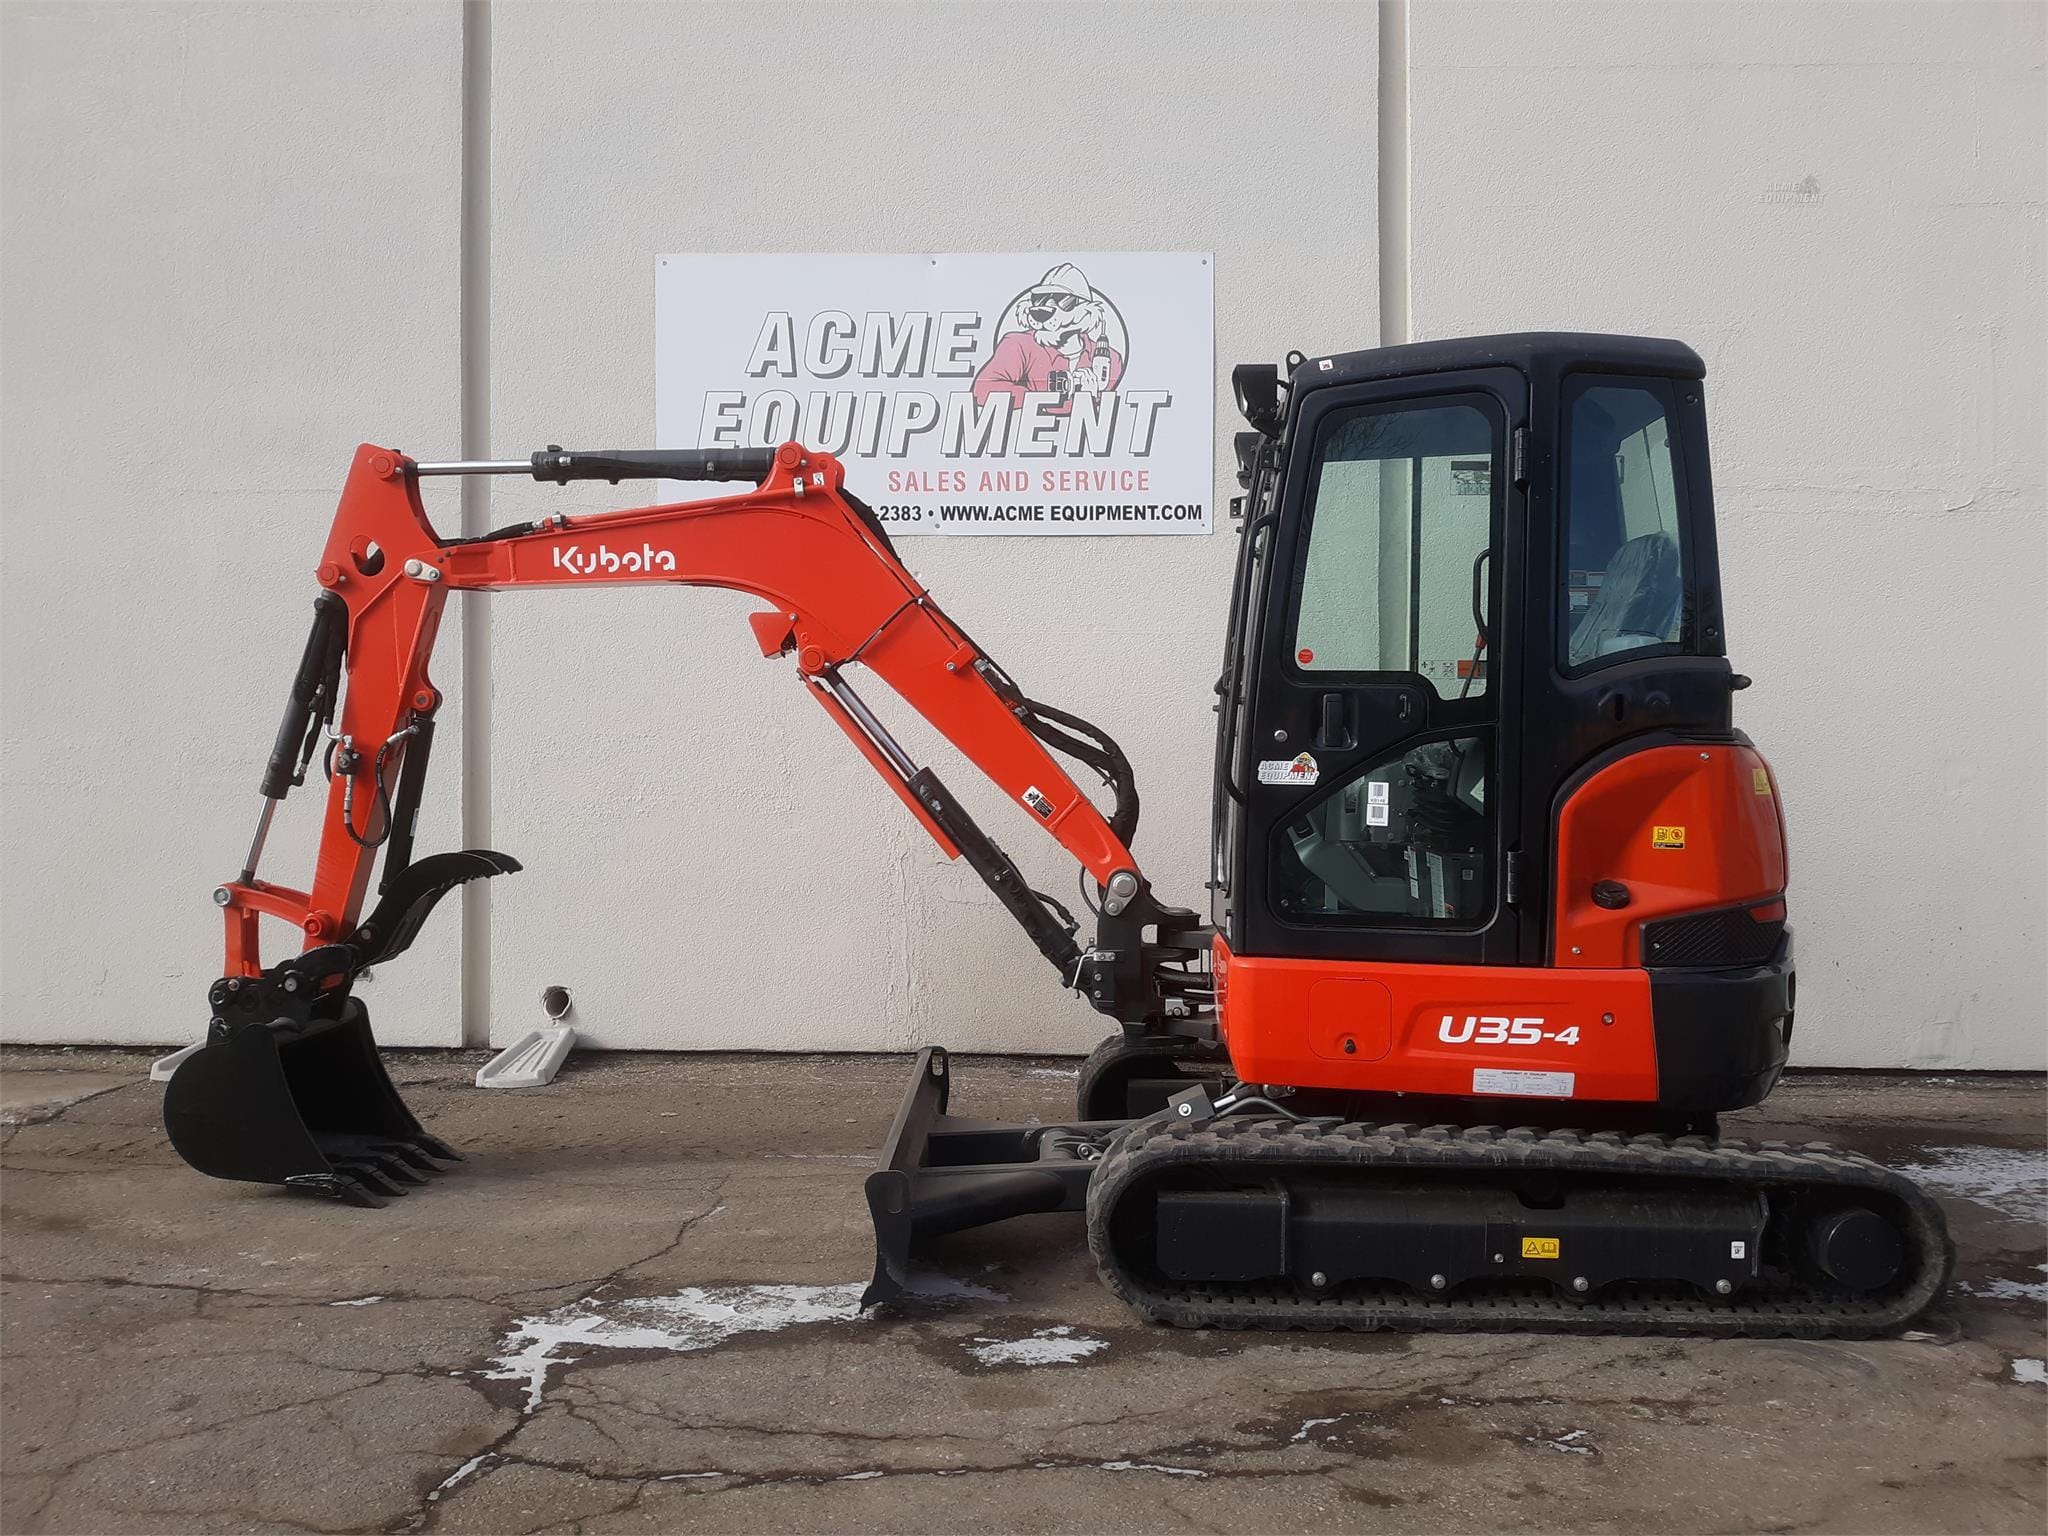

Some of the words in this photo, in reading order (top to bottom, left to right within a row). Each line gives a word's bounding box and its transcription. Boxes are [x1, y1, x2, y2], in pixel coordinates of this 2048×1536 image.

[744, 310, 980, 379] ACME
[697, 389, 1172, 459] EQUIPMENT
[888, 470, 967, 493] SALES
[979, 470, 1030, 492] AND
[1042, 470, 1150, 492] SERVICE
[872, 505, 922, 522] -2383
[941, 505, 1044, 522] WWW.ACME
[1050, 504, 1202, 522] EQUIPMENT.COM
[552, 543, 676, 575] Kubota
[1259, 771, 1319, 781] EQUIPMENT
[1260, 762, 1290, 771] ACME
[1438, 1015, 1580, 1046] U35-4
